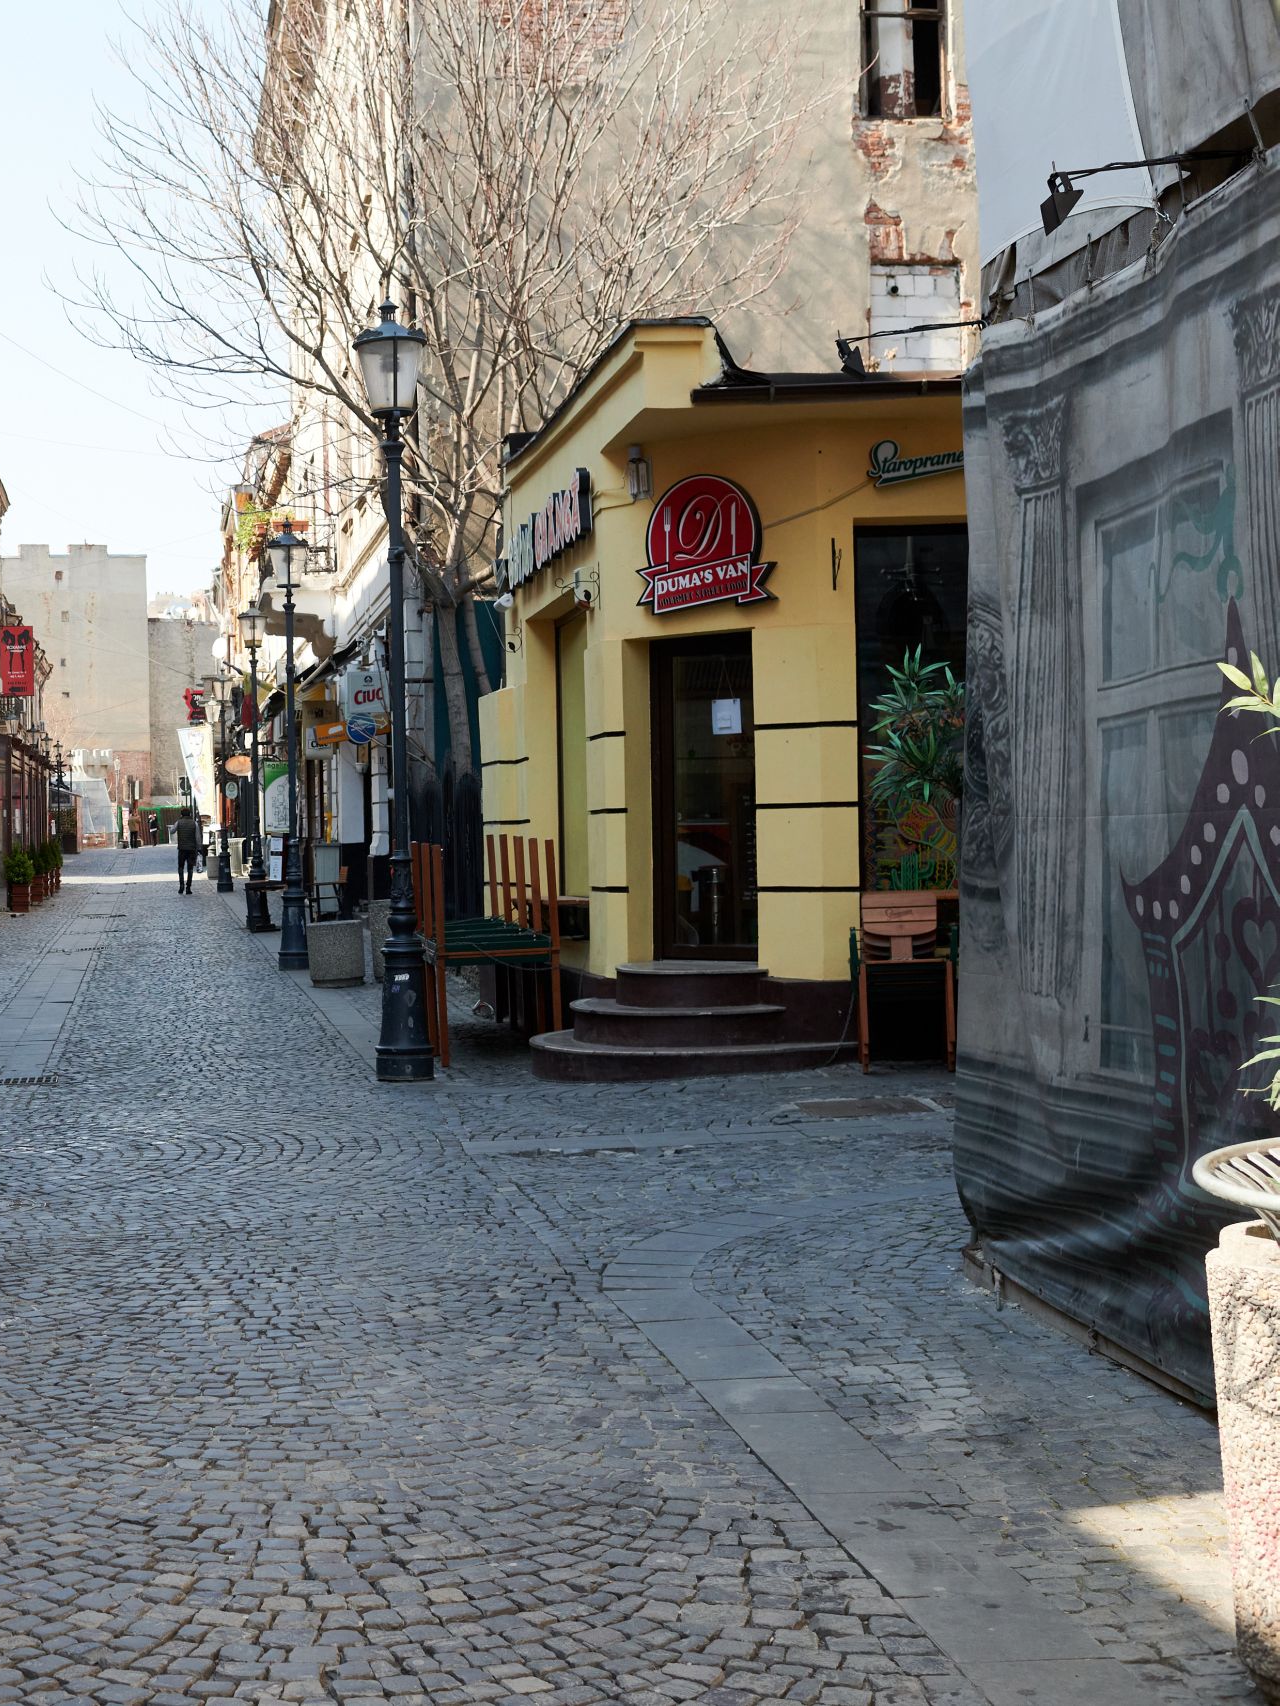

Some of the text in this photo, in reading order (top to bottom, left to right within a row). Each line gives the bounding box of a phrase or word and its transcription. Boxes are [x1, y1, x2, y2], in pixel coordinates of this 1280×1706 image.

[868, 440, 965, 479] Staroprame
[657, 561, 748, 595] DUMA'S VAN
